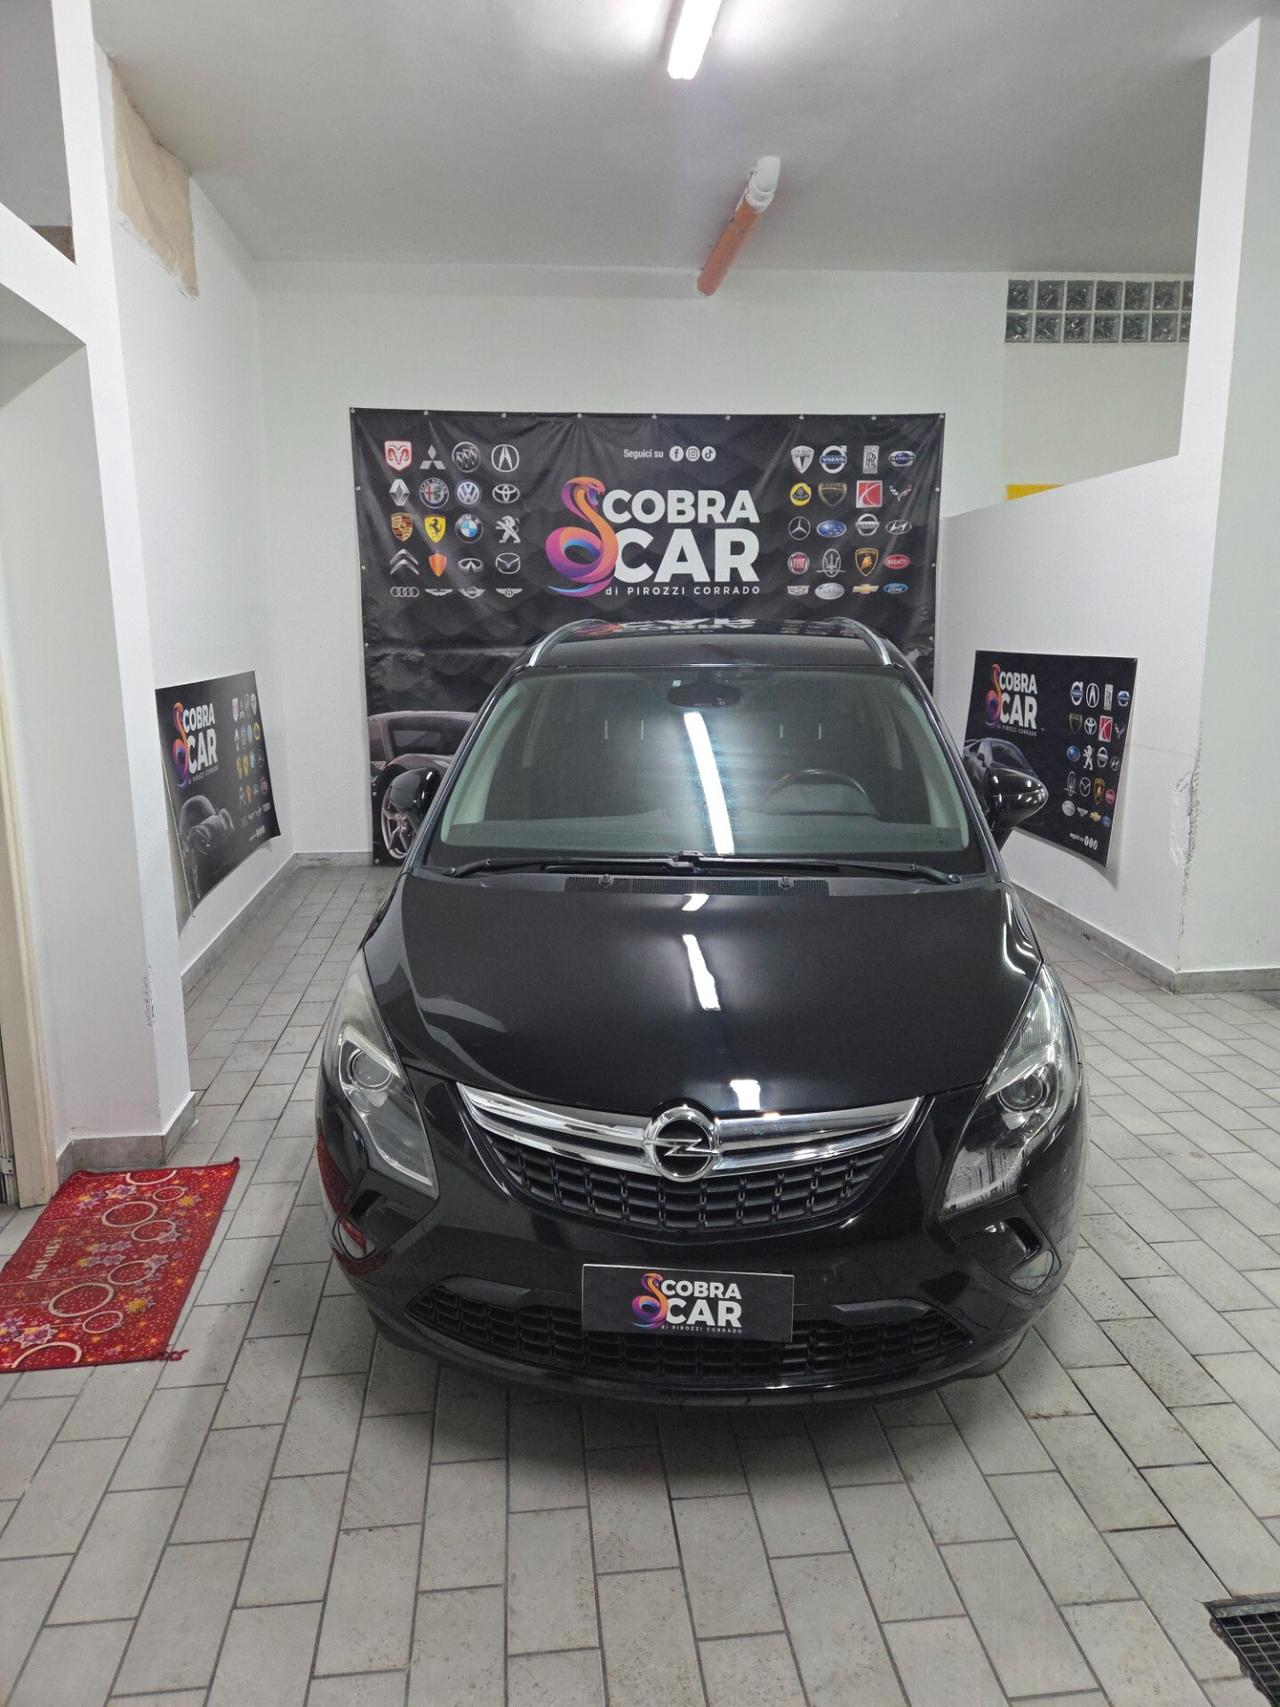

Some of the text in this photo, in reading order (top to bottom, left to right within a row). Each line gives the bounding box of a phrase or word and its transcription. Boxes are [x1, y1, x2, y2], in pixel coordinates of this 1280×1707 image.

[623, 448, 664, 461] Seguici su
[602, 489, 760, 524] COBRA
[612, 528, 760, 583] CAR
[605, 585, 760, 596] di PIROZZI CORRADO
[999, 671, 1037, 695] COBRA
[182, 702, 216, 733] COBRA
[1000, 692, 1037, 729] CAR
[187, 728, 218, 774] CAR
[661, 1279, 742, 1300] COBRA
[665, 1297, 742, 1328] CAR
